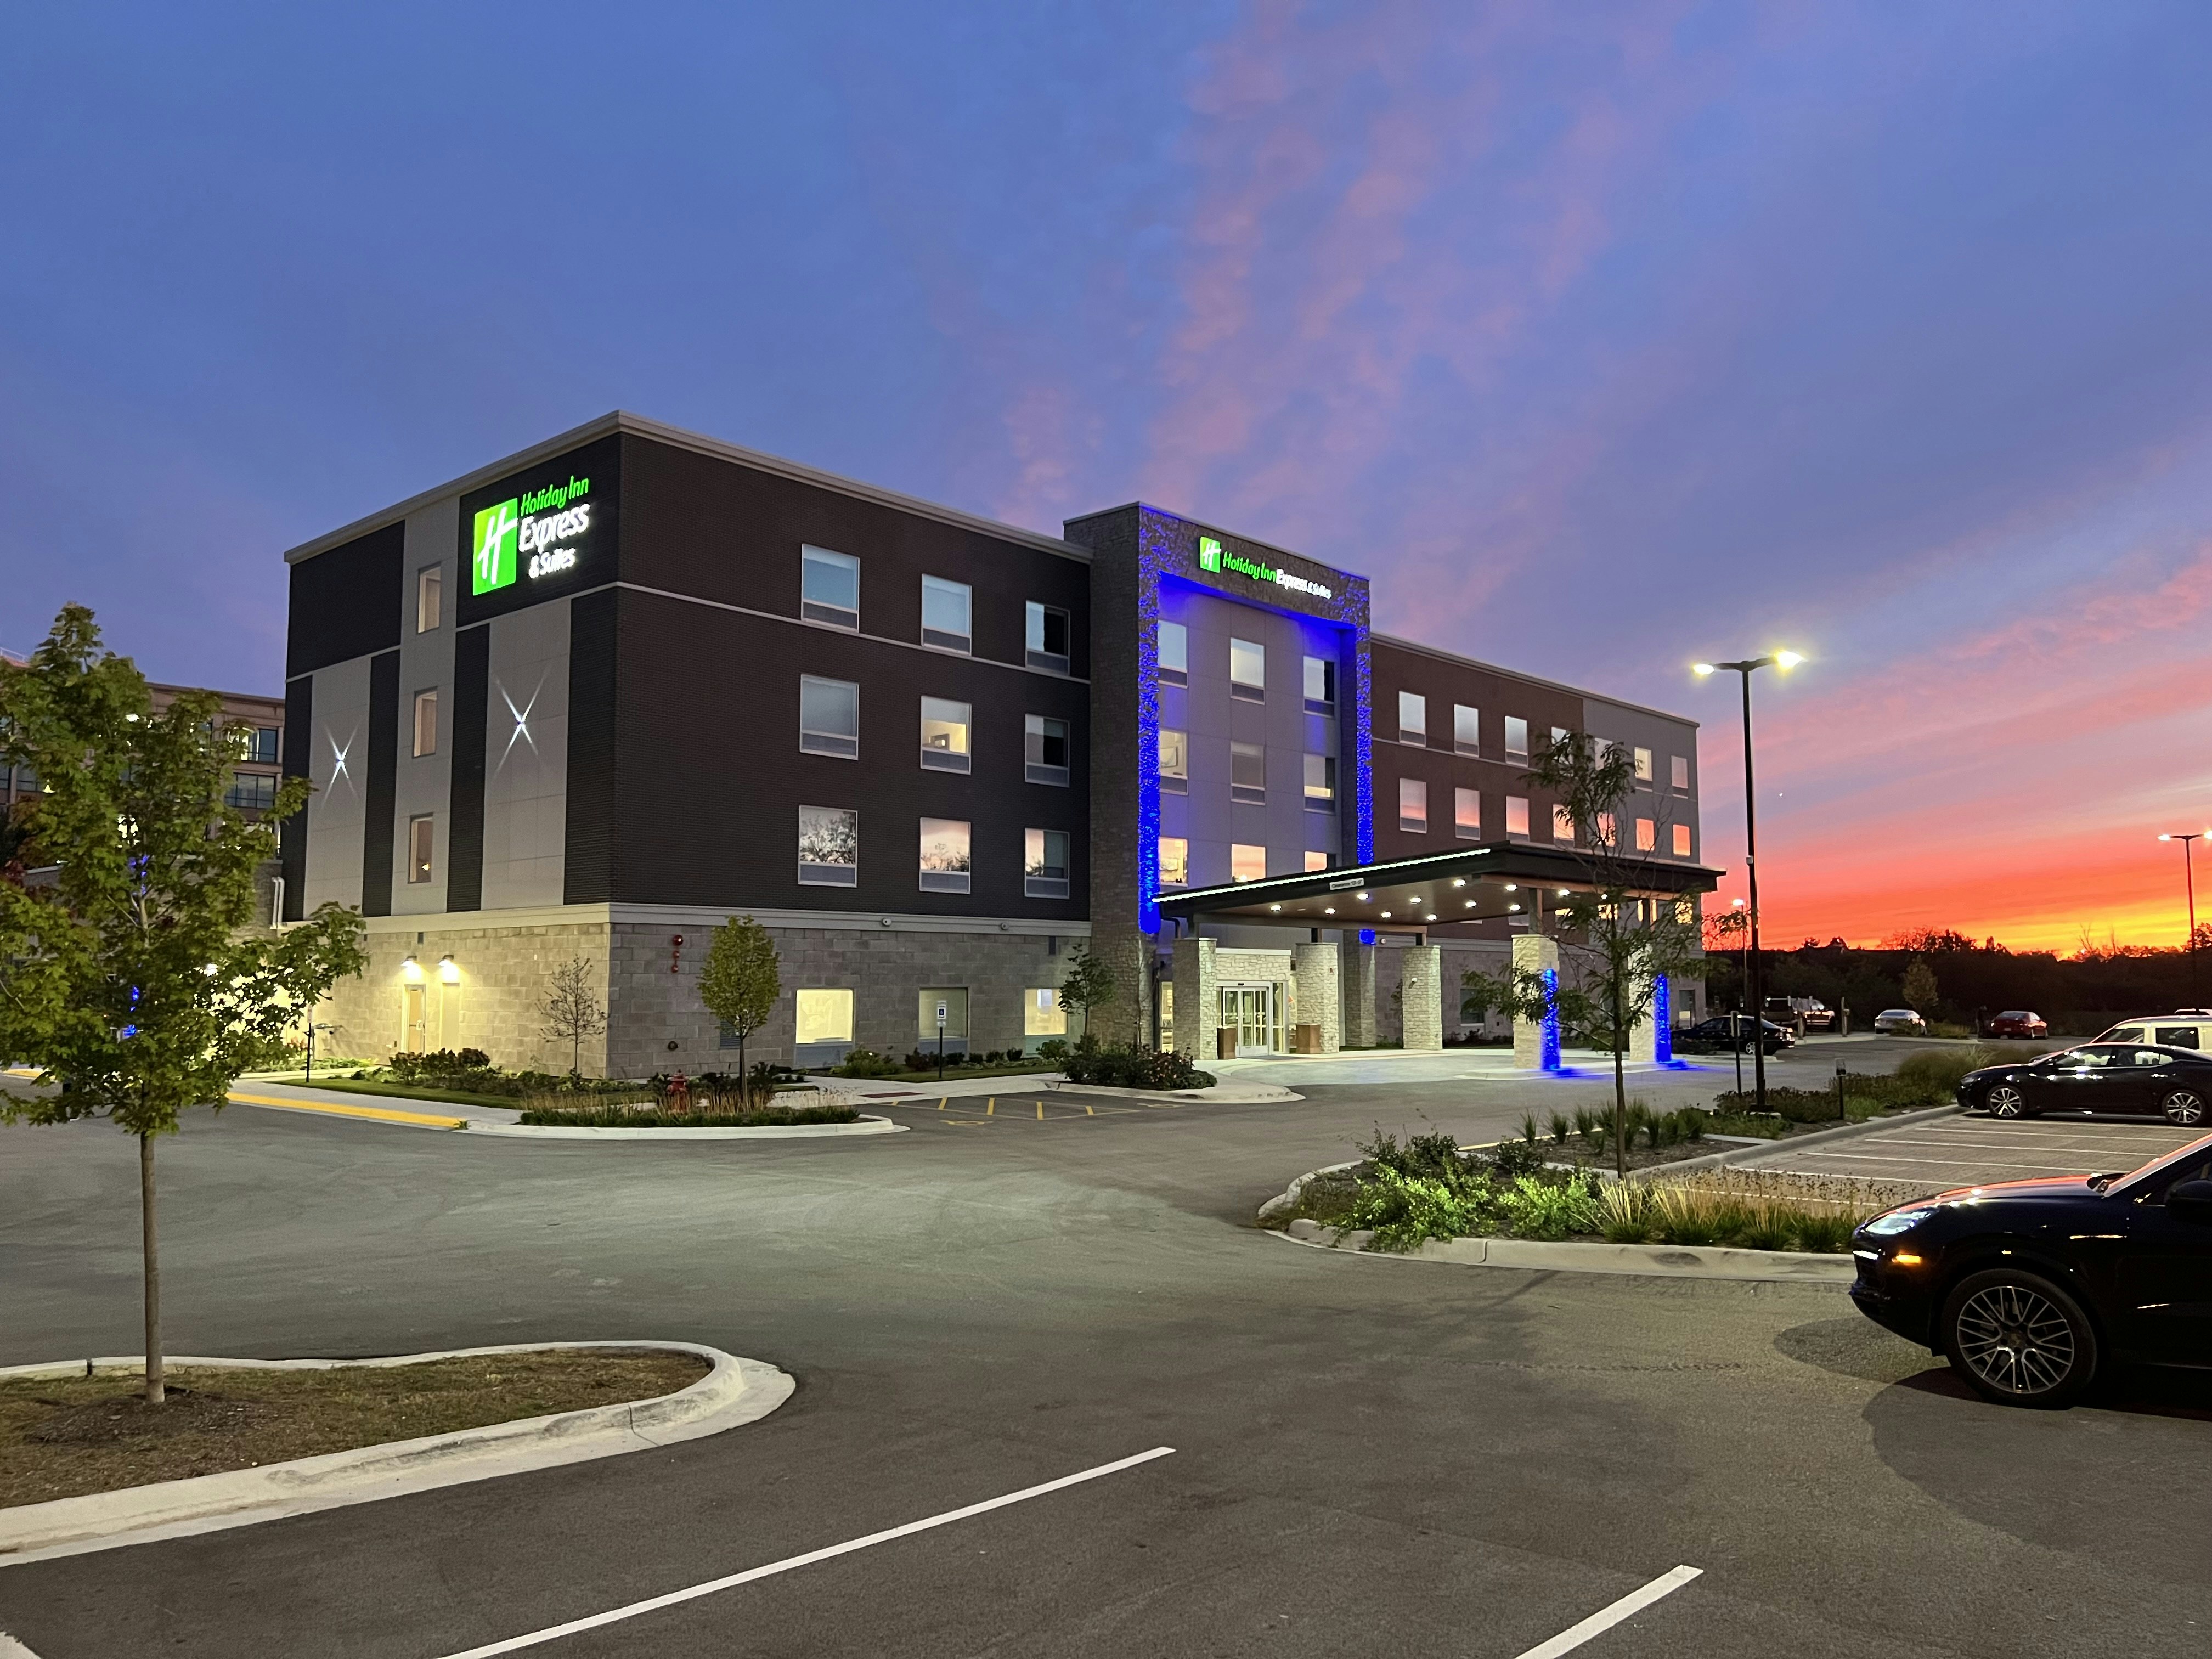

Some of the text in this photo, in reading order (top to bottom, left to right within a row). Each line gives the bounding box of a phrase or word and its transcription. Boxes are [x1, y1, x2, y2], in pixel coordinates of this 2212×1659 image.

[521, 475, 589, 516] Holiday Inn
[518, 504, 590, 553] Express
[528, 548, 576, 578] & Suites
[1223, 551, 1260, 580] Holiday
[1261, 562, 1277, 583] Inn
[1276, 568, 1308, 591] Express
